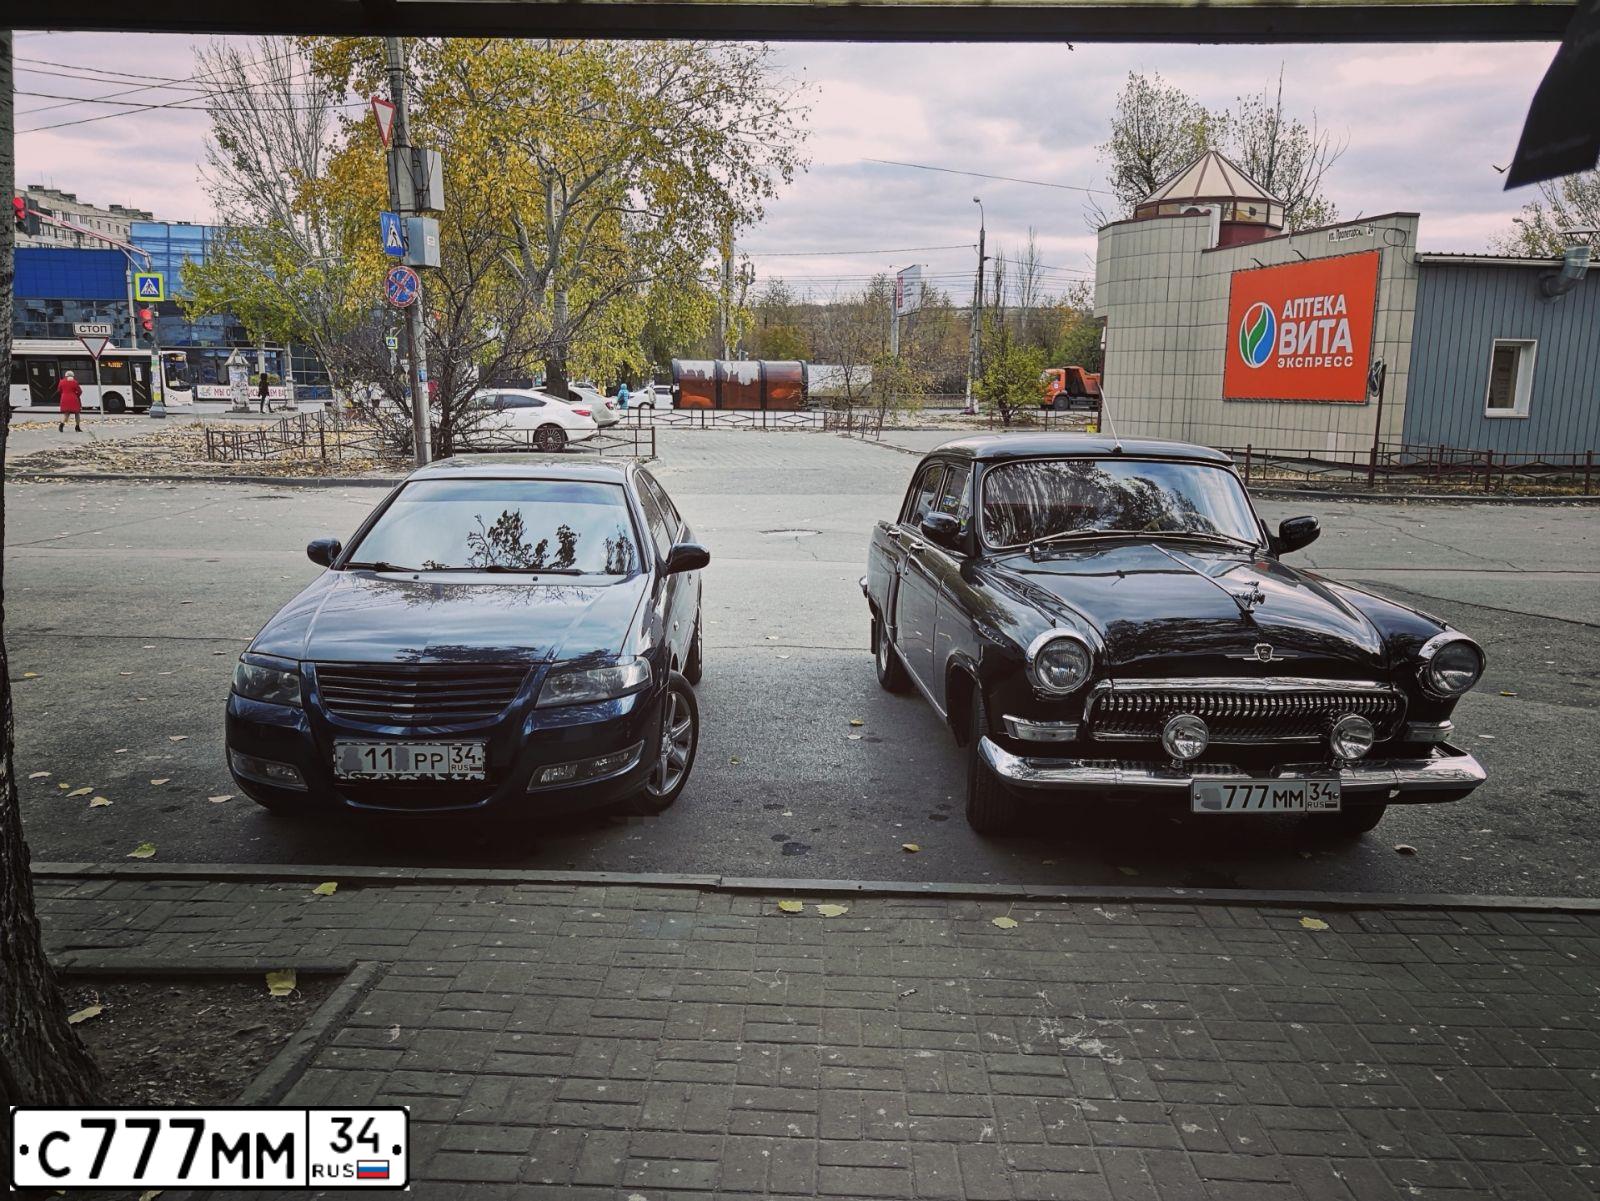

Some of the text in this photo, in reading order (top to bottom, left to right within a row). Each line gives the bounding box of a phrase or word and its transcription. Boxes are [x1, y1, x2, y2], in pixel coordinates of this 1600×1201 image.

[1281, 294, 1347, 320] АПТЕКА
[79, 325, 107, 333] СТОП
[1279, 318, 1354, 355] ВИТА
[1277, 356, 1353, 369] ЭКСПРЕСС
[452, 746, 476, 764] 34
[451, 764, 469, 772] RUS
[1309, 783, 1332, 801] 34
[1307, 801, 1325, 809] RUS
